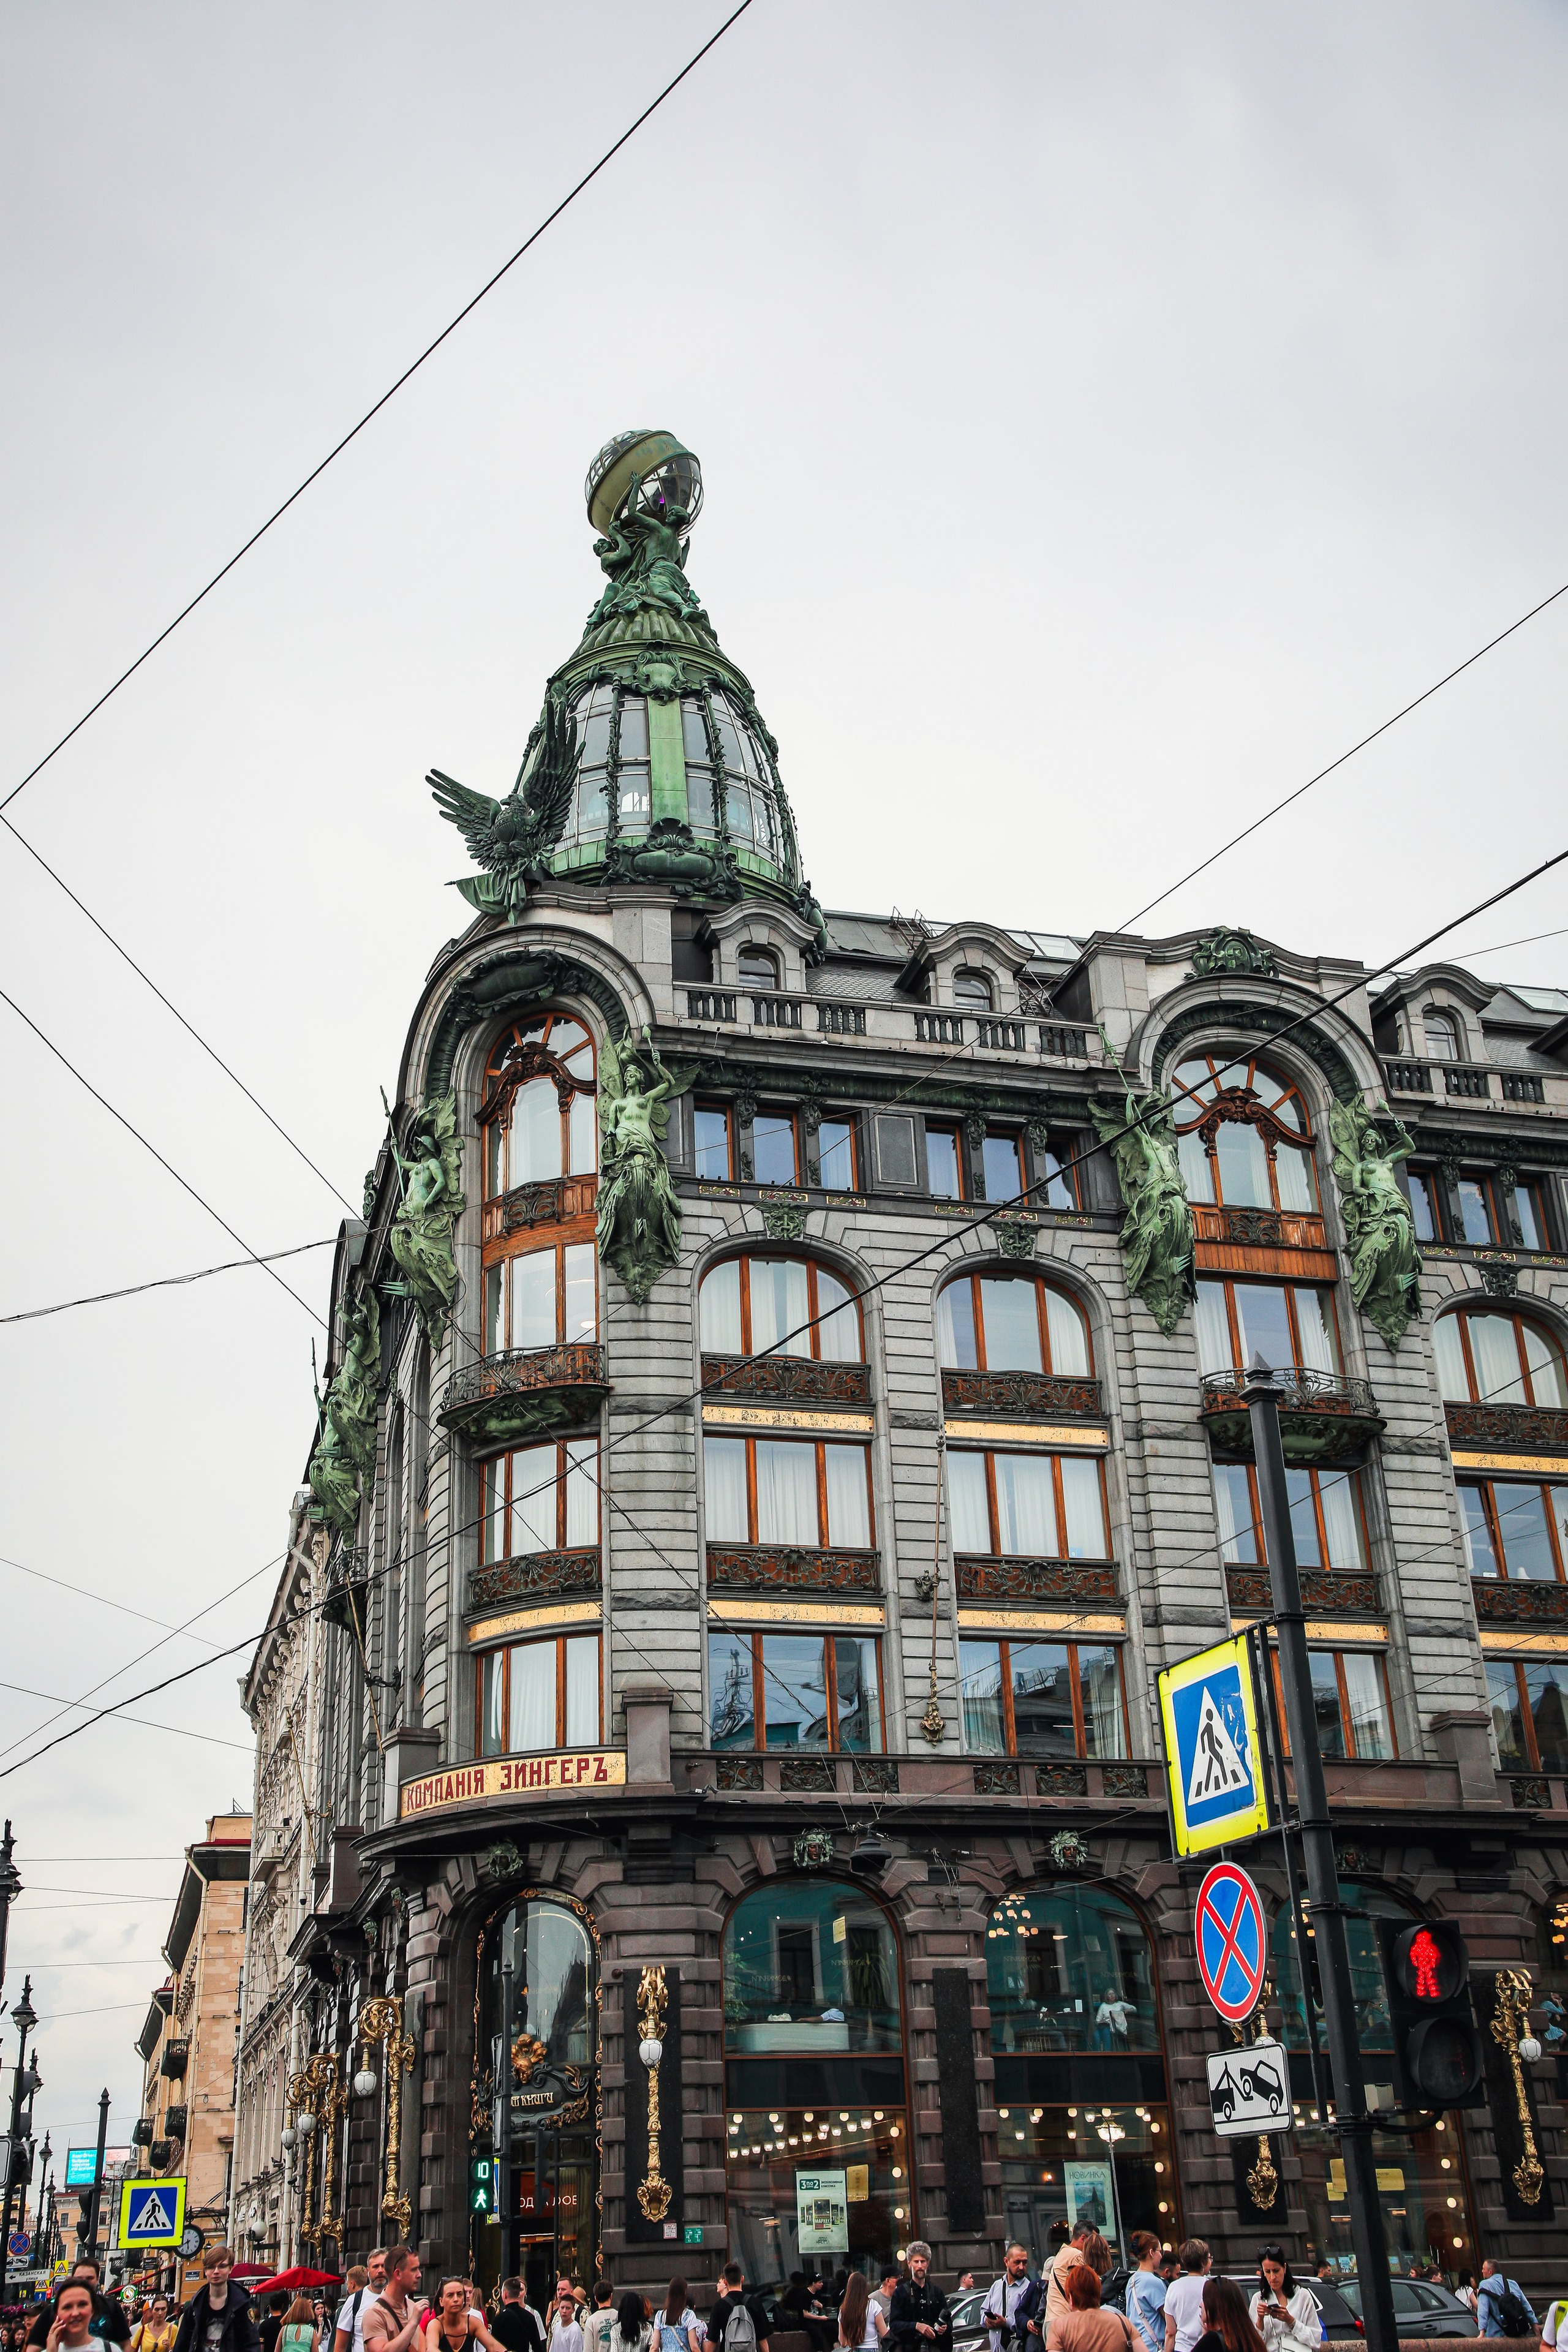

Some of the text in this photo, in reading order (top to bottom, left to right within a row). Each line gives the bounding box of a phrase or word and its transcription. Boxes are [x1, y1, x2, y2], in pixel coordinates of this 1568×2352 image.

[406, 1756, 608, 1811] КОМПАНІЯ ЗИНГЕРЪ
[478, 2163, 489, 2178] 10
[1069, 2171, 1106, 2180] НОВИНКА
[801, 2180, 806, 2189] 3
[813, 2180, 819, 2189] 2
